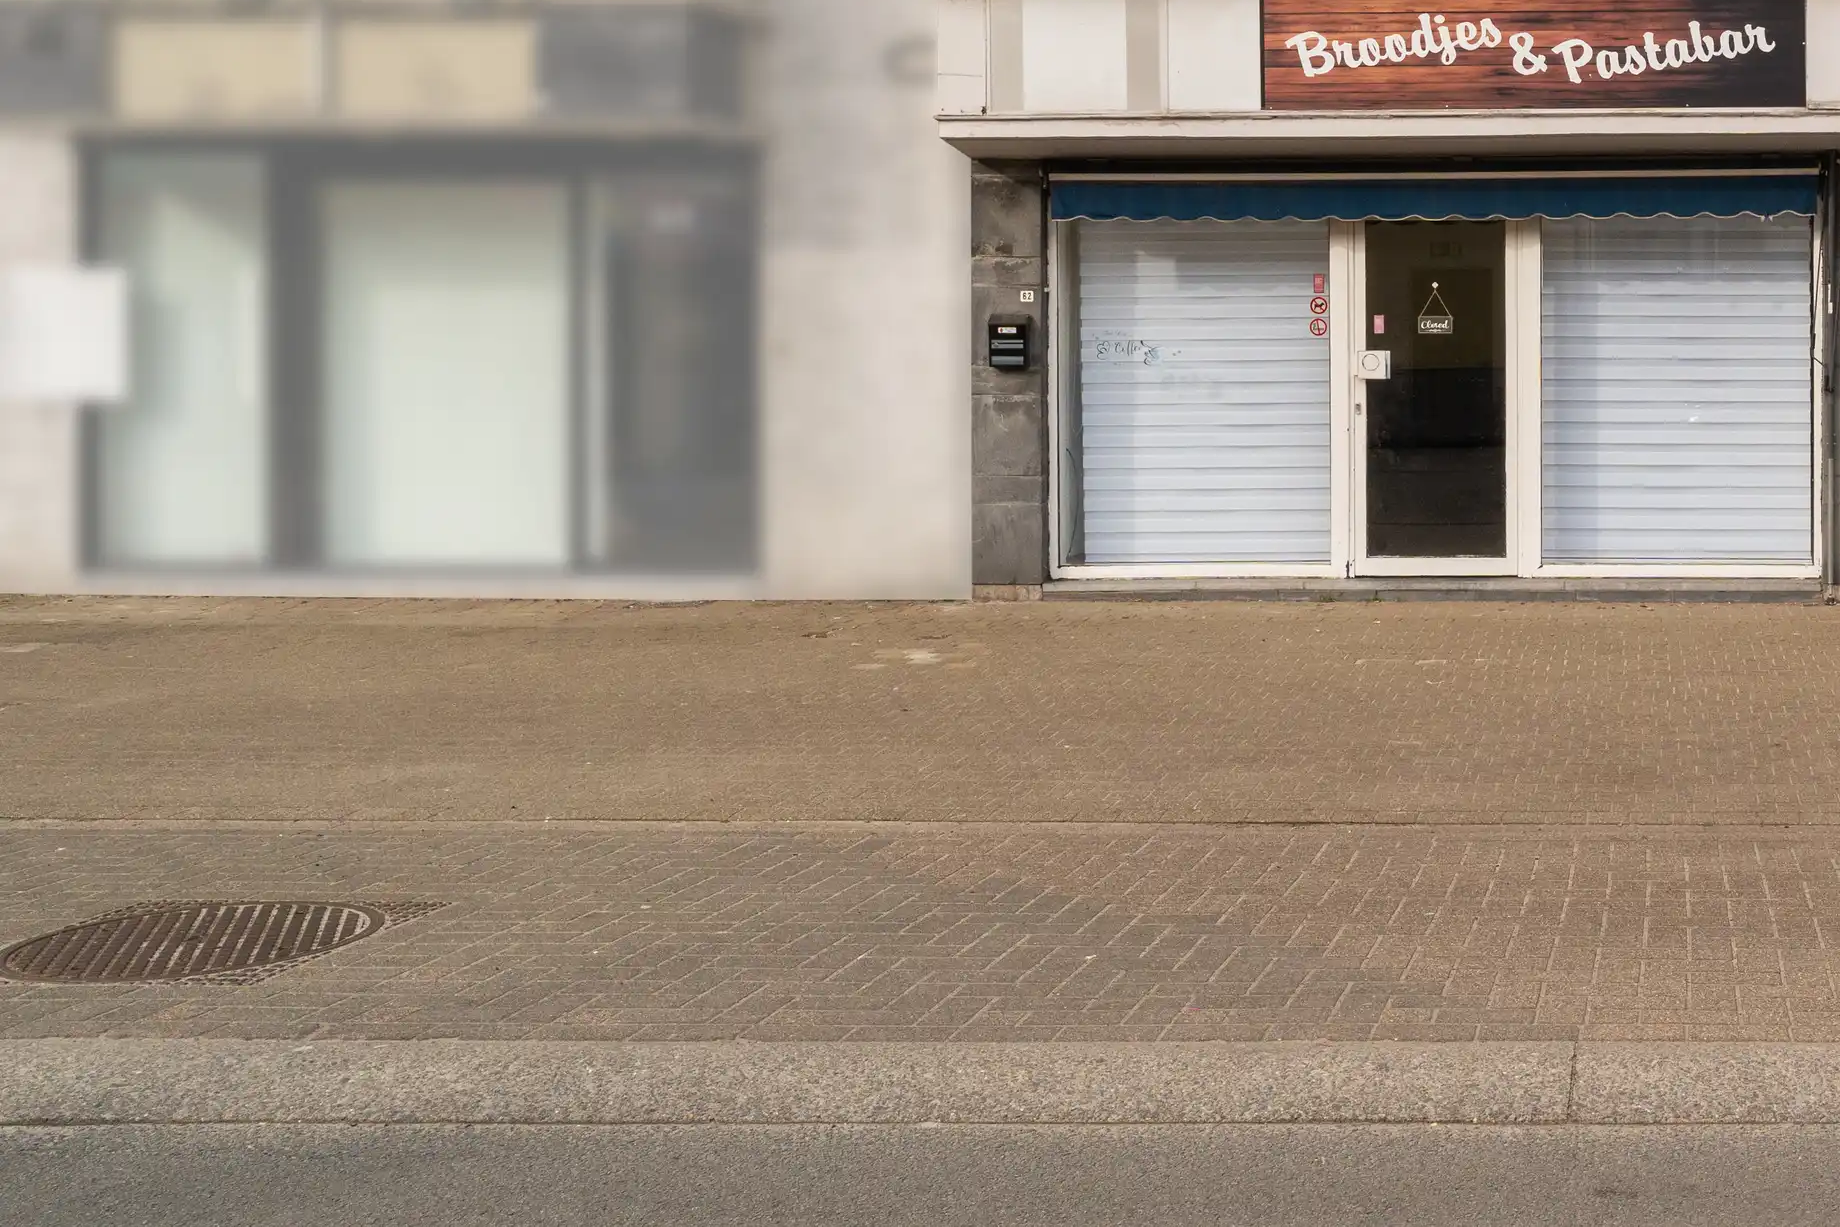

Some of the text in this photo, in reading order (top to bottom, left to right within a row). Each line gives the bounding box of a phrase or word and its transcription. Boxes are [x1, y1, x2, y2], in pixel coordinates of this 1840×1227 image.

[1286, 12, 1777, 84] Broodjes & Pastabar
[1022, 292, 1033, 300] 62
[1420, 319, 1450, 330] Closed
